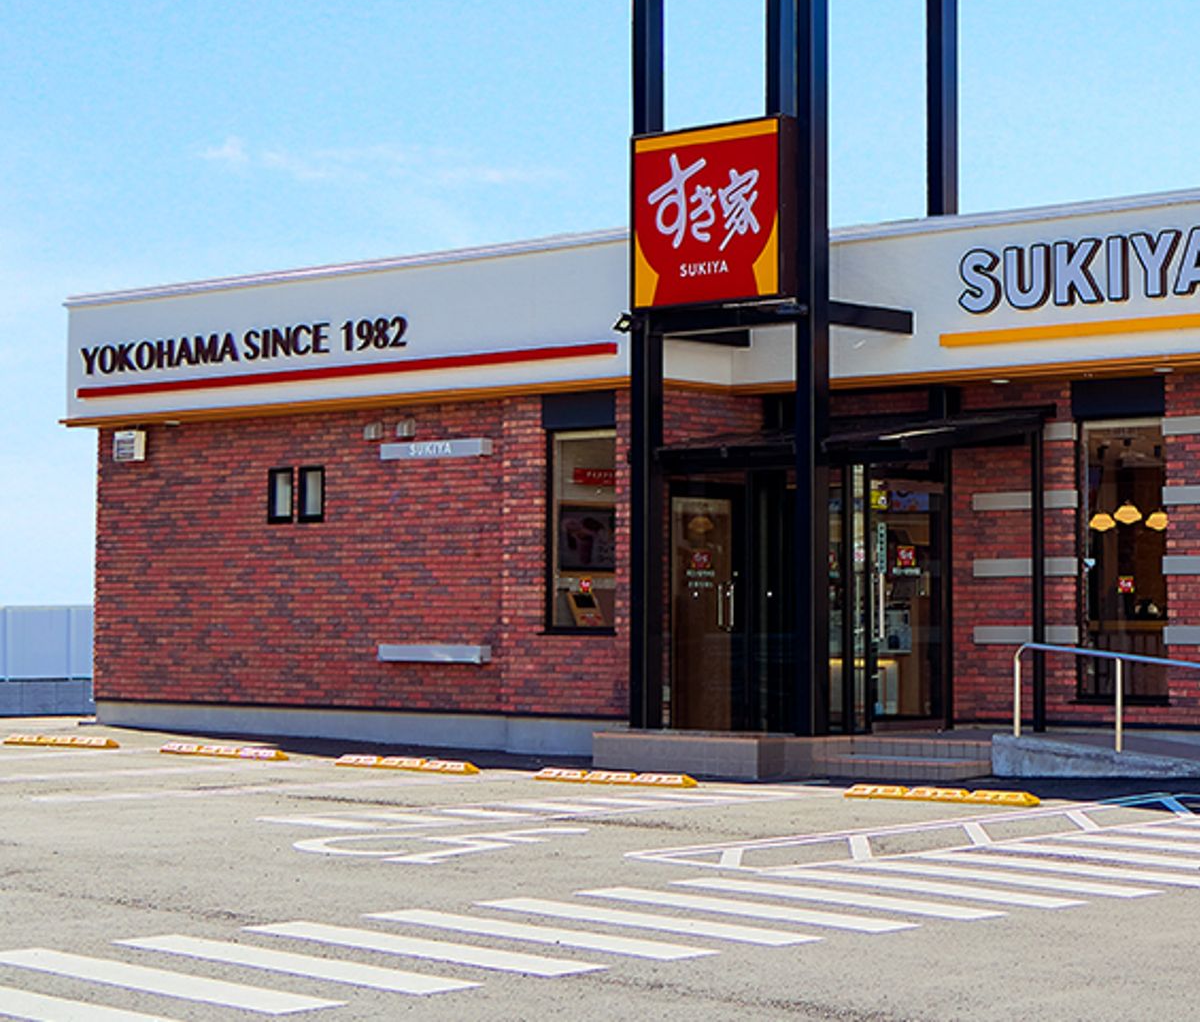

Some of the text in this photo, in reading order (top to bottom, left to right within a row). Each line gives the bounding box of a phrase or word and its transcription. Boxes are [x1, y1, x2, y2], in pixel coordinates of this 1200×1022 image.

[648, 153, 760, 251] すき家
[680, 260, 729, 277] SUKIYA
[81, 316, 408, 375] YOKOHAMA SINCE 1982
[409, 442, 452, 456] SUKIYA
